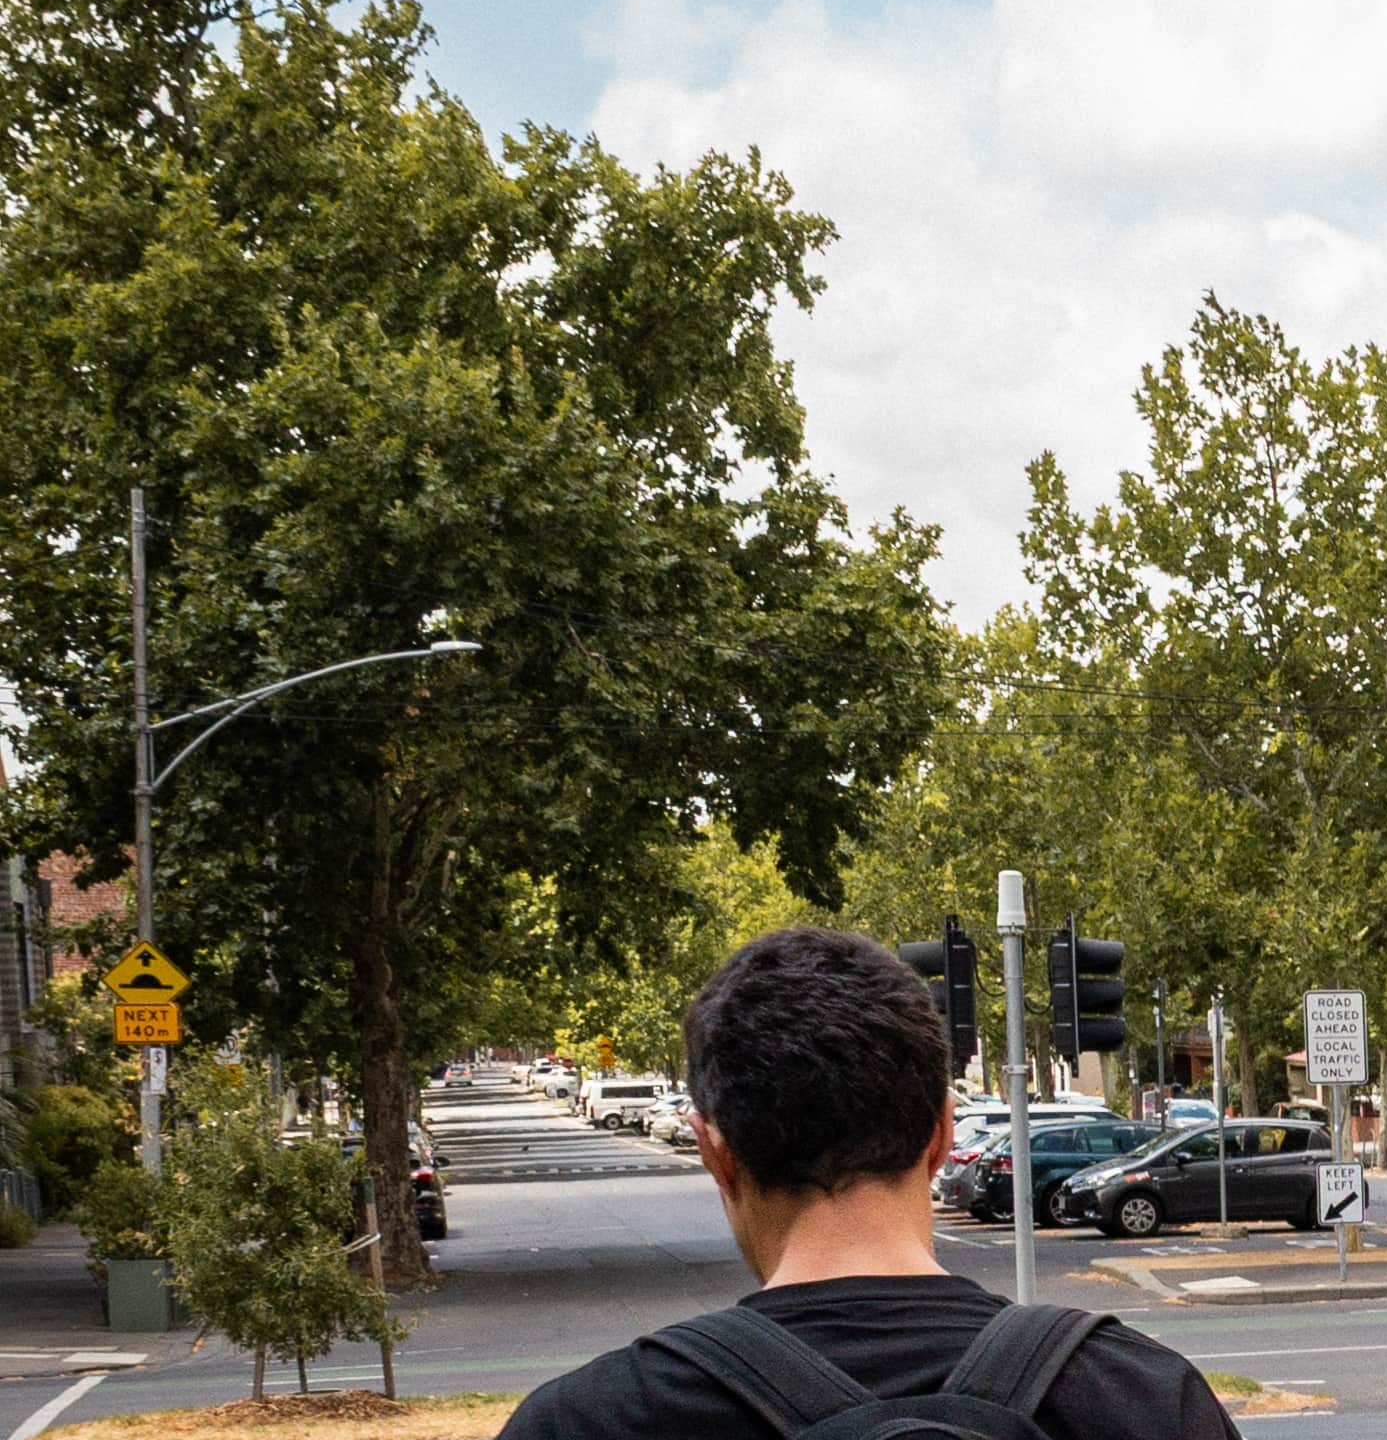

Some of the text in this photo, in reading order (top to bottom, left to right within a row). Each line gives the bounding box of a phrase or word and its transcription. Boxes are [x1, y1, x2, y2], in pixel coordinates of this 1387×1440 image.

[1318, 998, 1352, 1007] ROAD
[123, 1010, 169, 1022] NEXT
[1311, 1011, 1359, 1021] CLOSED
[1315, 1023, 1357, 1033] AHEAD
[1316, 1041, 1356, 1052] LOCAL
[1313, 1054, 1360, 1064] TRAFFIC
[1321, 1068, 1352, 1078] ONLY
[1326, 1168, 1354, 1178] KEEP
[1327, 1180, 1353, 1191] LEFT
